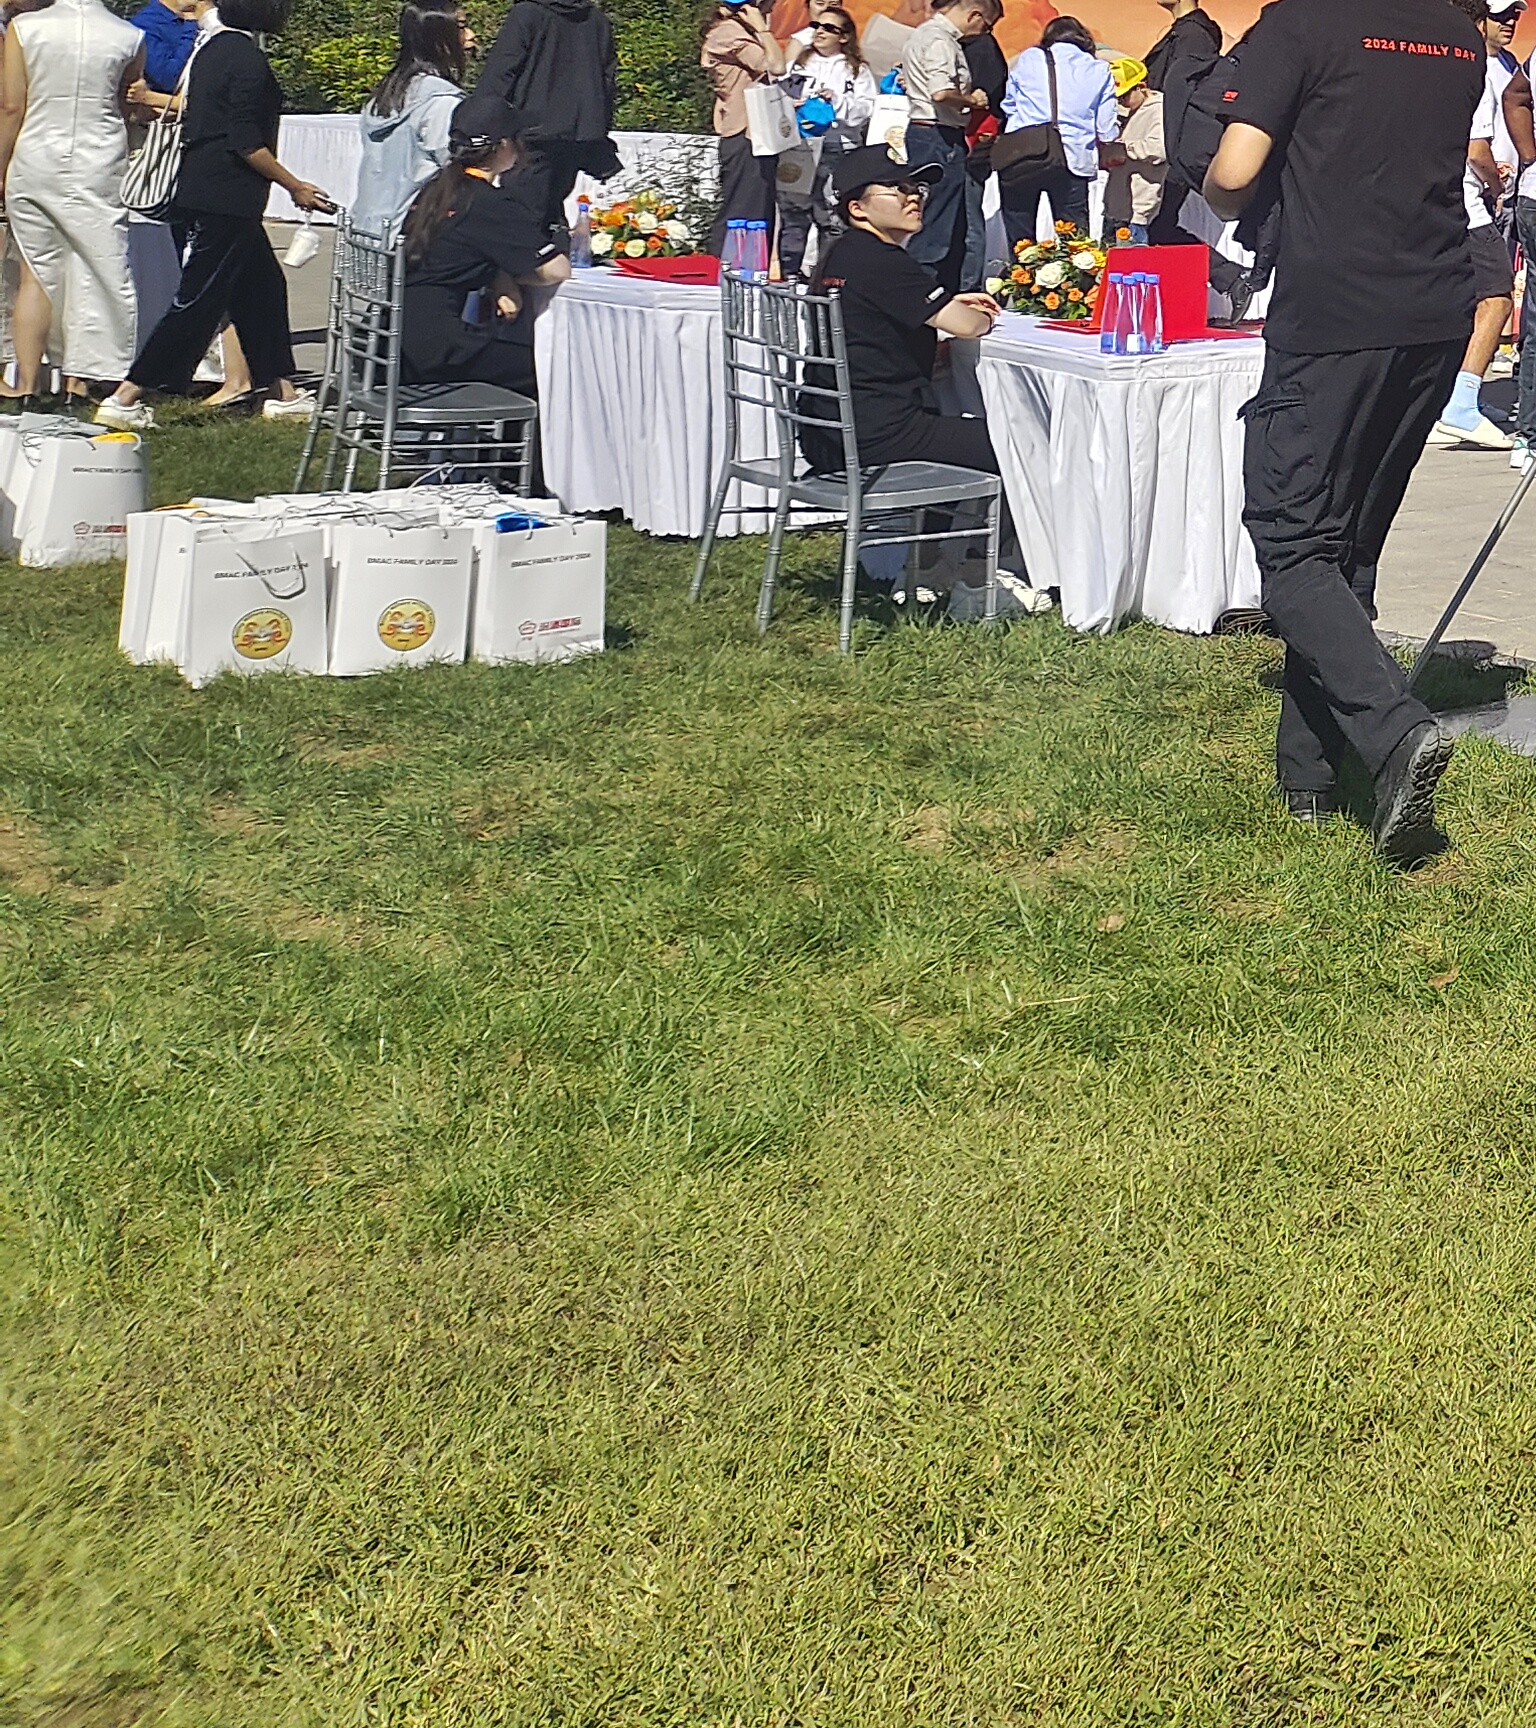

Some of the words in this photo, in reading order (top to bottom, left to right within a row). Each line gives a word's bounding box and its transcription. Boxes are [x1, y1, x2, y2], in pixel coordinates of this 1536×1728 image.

[1362, 37, 1396, 52] 2024
[1399, 40, 1449, 57] FAMILY
[1454, 47, 1477, 62] DAY
